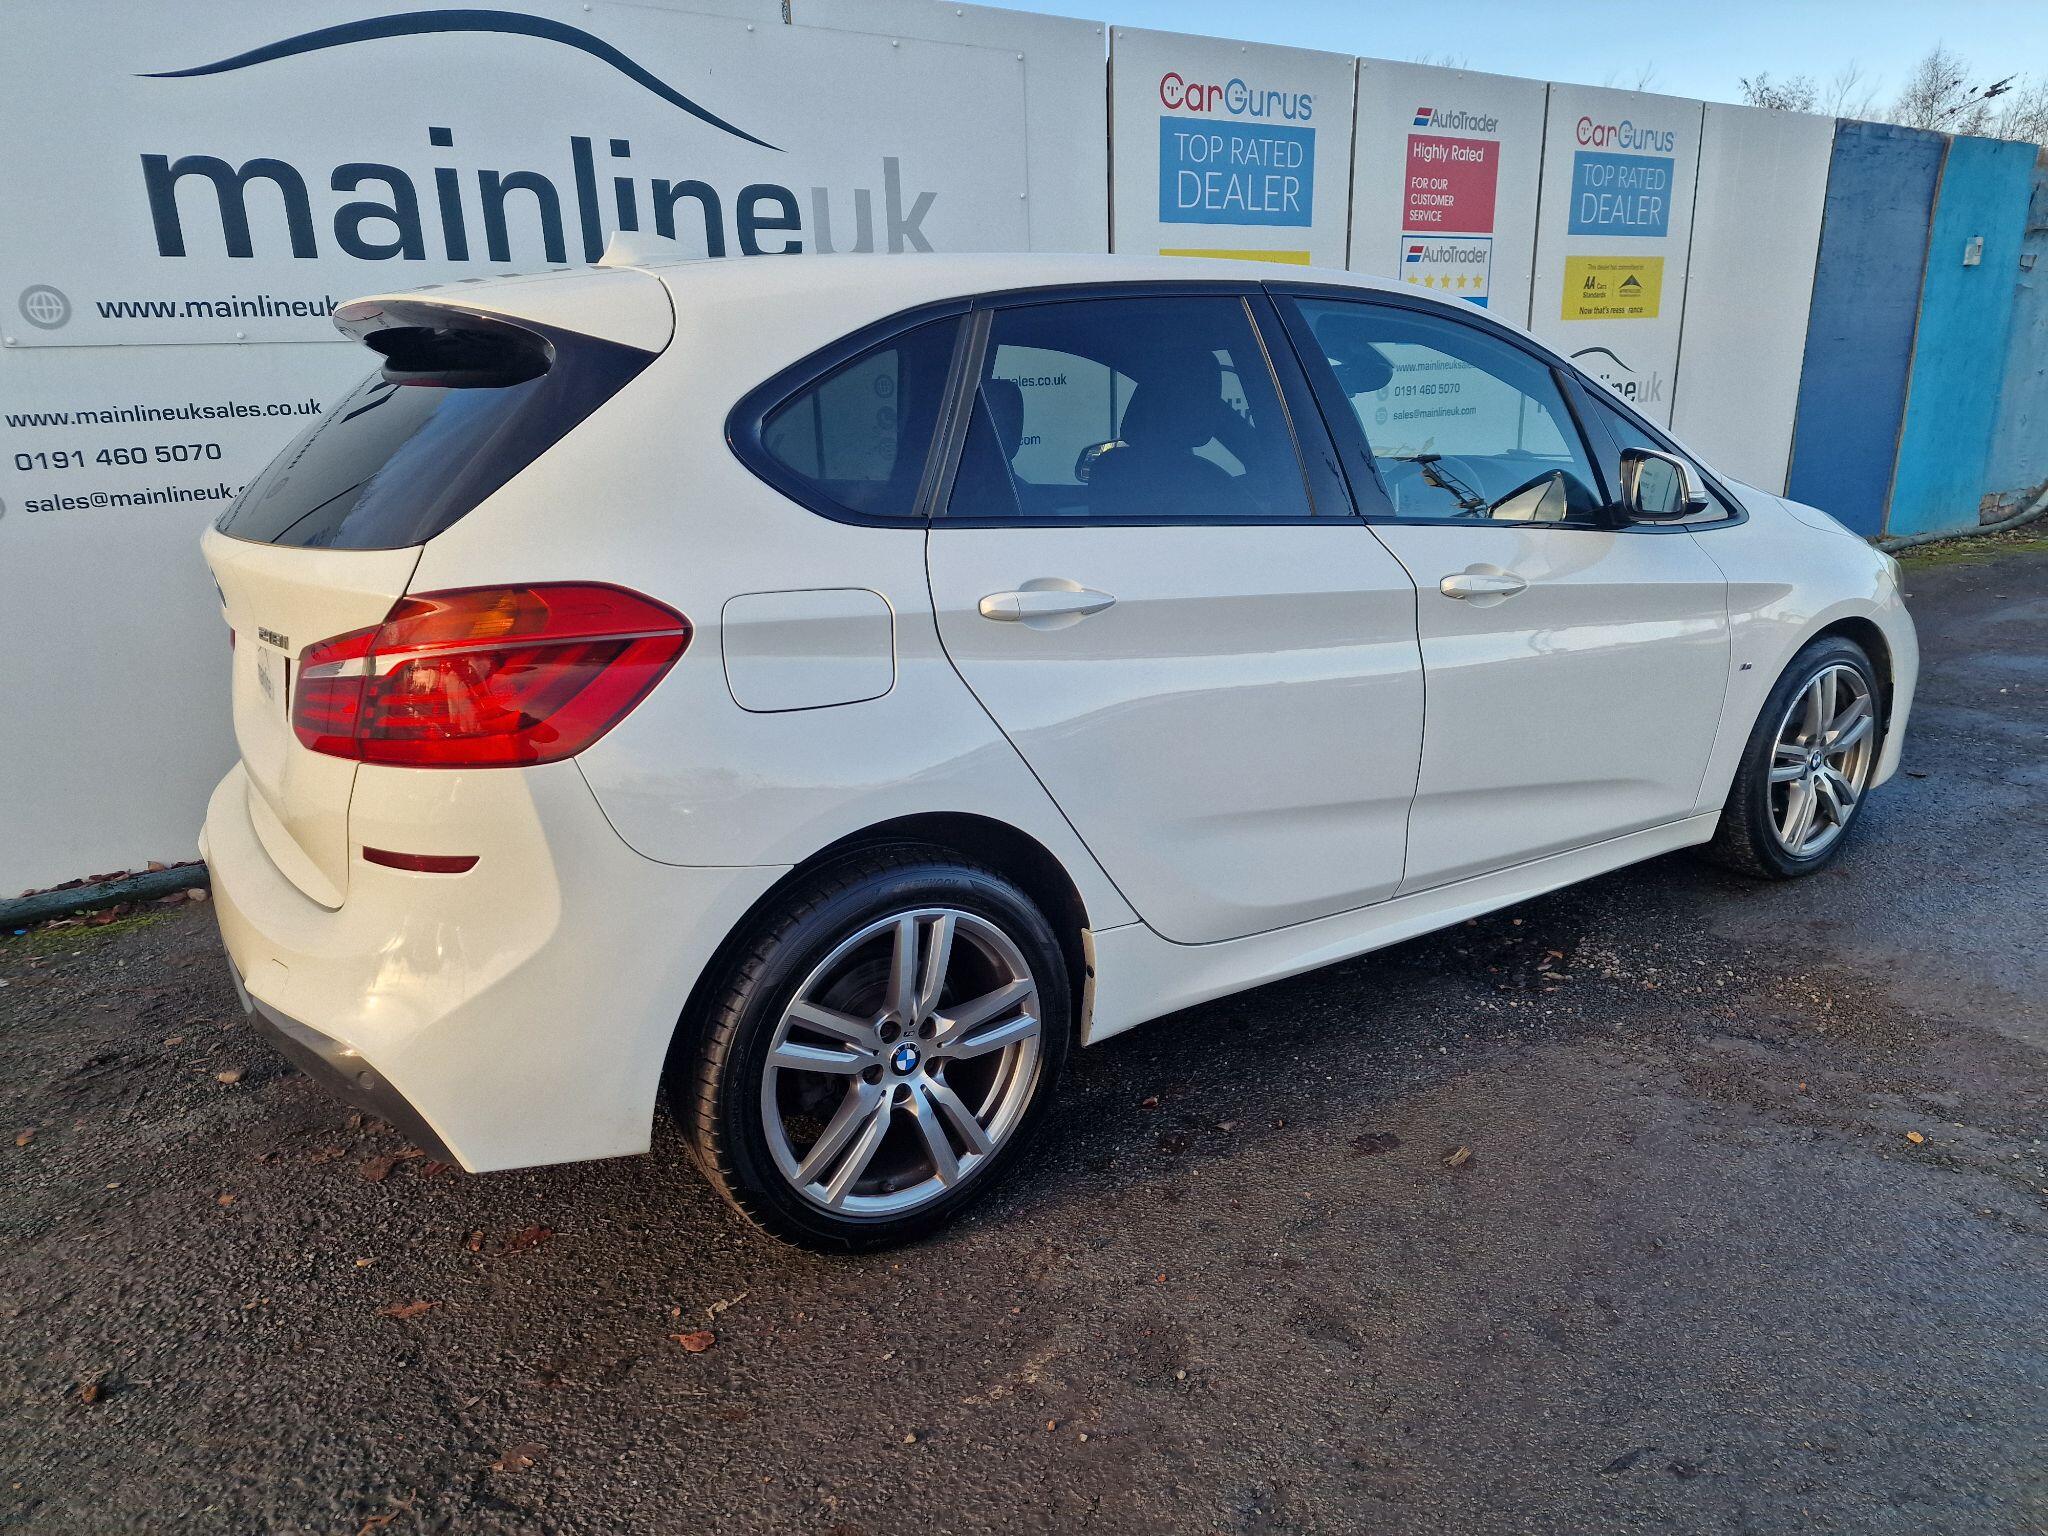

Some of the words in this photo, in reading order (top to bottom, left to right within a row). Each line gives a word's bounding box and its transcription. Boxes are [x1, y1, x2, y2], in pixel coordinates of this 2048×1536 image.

[1160, 72, 1313, 121] CarGurus
[1429, 108, 1499, 133] AutoTrader
[1576, 116, 1675, 152] CarGurus
[1174, 132, 1224, 163] TOP
[1230, 136, 1303, 169] RATED
[1413, 142, 1450, 163] Highly
[1451, 145, 1484, 163] Rated
[1411, 176, 1429, 190] FOR
[1430, 178, 1448, 190] OUR
[1582, 163, 1615, 187] TOP
[1618, 165, 1666, 191] RATED
[1177, 170, 1300, 213] DEALER
[1410, 193, 1455, 207] CUSTOMER
[1409, 209, 1442, 222] SERVICE
[1580, 192, 1663, 226] DEALER
[1421, 245, 1488, 264] AutoTrader
[1579, 306, 1592, 315] Now
[1593, 306, 1610, 314] that's
[1394, 385, 1417, 397] 0191
[1420, 384, 1436, 395] 460
[1438, 383, 1460, 394] 5070
[5, 398, 323, 428] www.mainlineuksales.co.uk
[1393, 406, 1477, 420] sales@mainlineuk.com
[14, 450, 85, 471] 0191
[96, 447, 148, 466] 460
[156, 443, 222, 464] 5070
